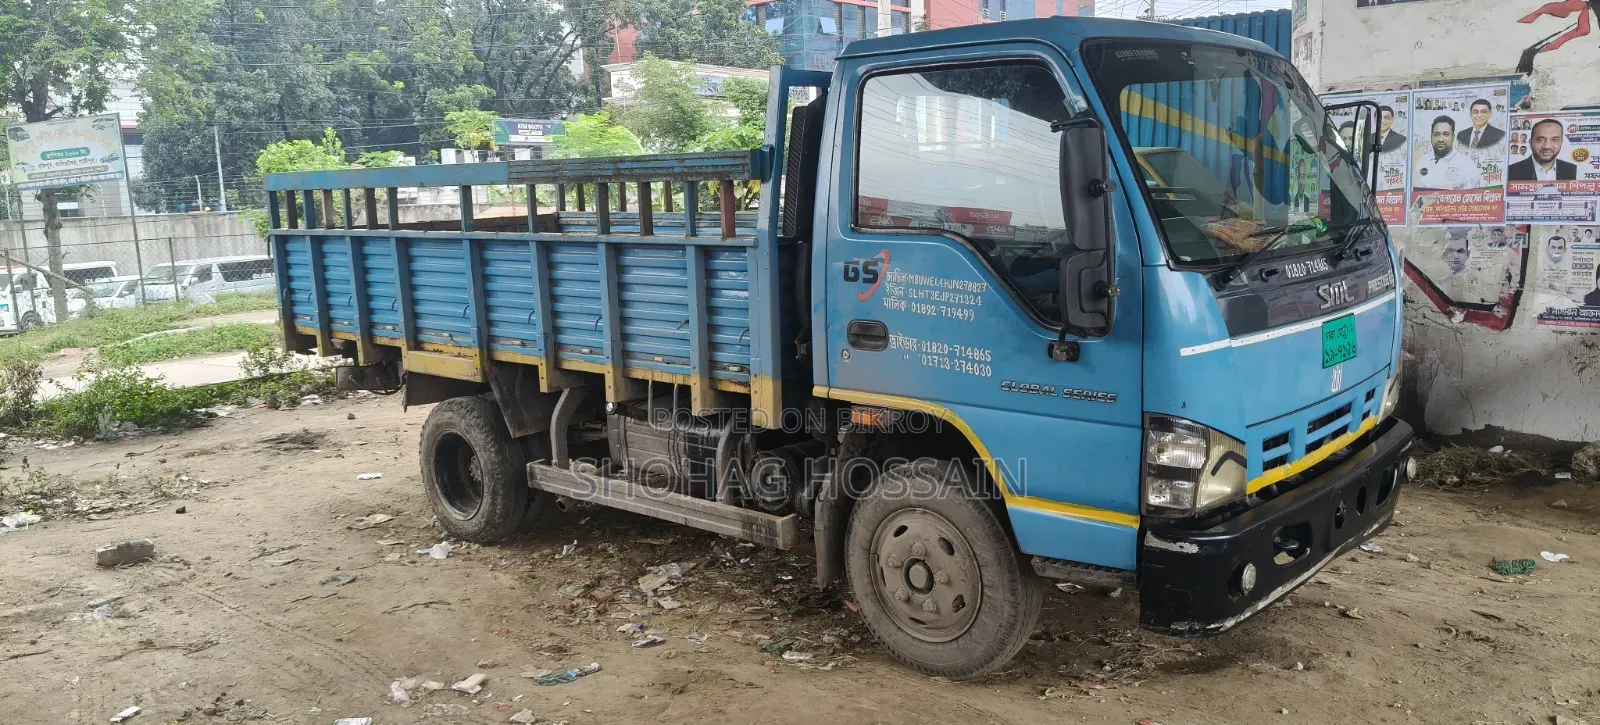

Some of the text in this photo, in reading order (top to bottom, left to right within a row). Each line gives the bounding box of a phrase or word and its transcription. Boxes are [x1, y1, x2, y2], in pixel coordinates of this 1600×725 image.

[843, 260, 879, 285] GS
[1316, 280, 1355, 310] SML
[1001, 380, 1117, 403] GLOBAL SERIES
